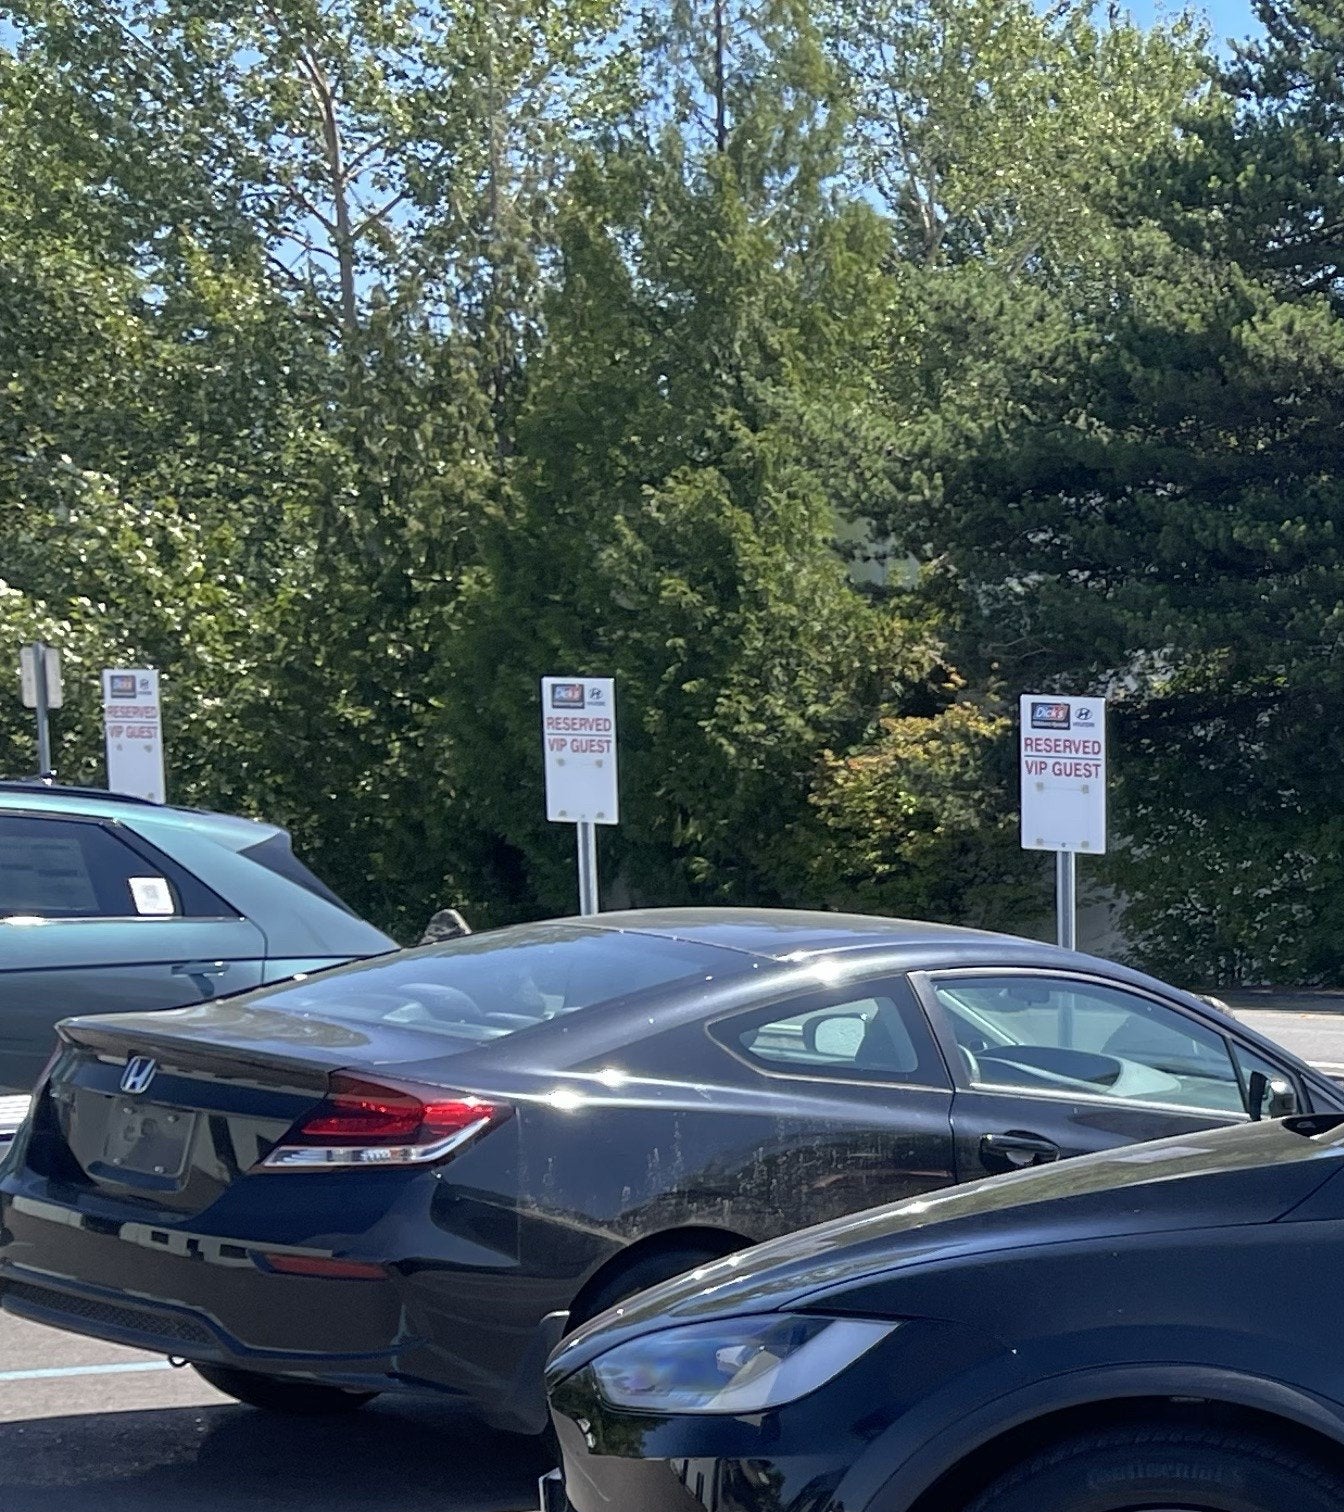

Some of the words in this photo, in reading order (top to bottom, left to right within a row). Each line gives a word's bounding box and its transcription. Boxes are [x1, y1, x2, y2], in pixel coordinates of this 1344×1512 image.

[546, 717, 612, 732] RESERVED
[548, 738, 568, 752] VIP
[570, 739, 612, 753] GUEST
[1024, 737, 1102, 756] RESERVED
[1025, 760, 1048, 775] VIP
[1052, 762, 1102, 778] GUEST
